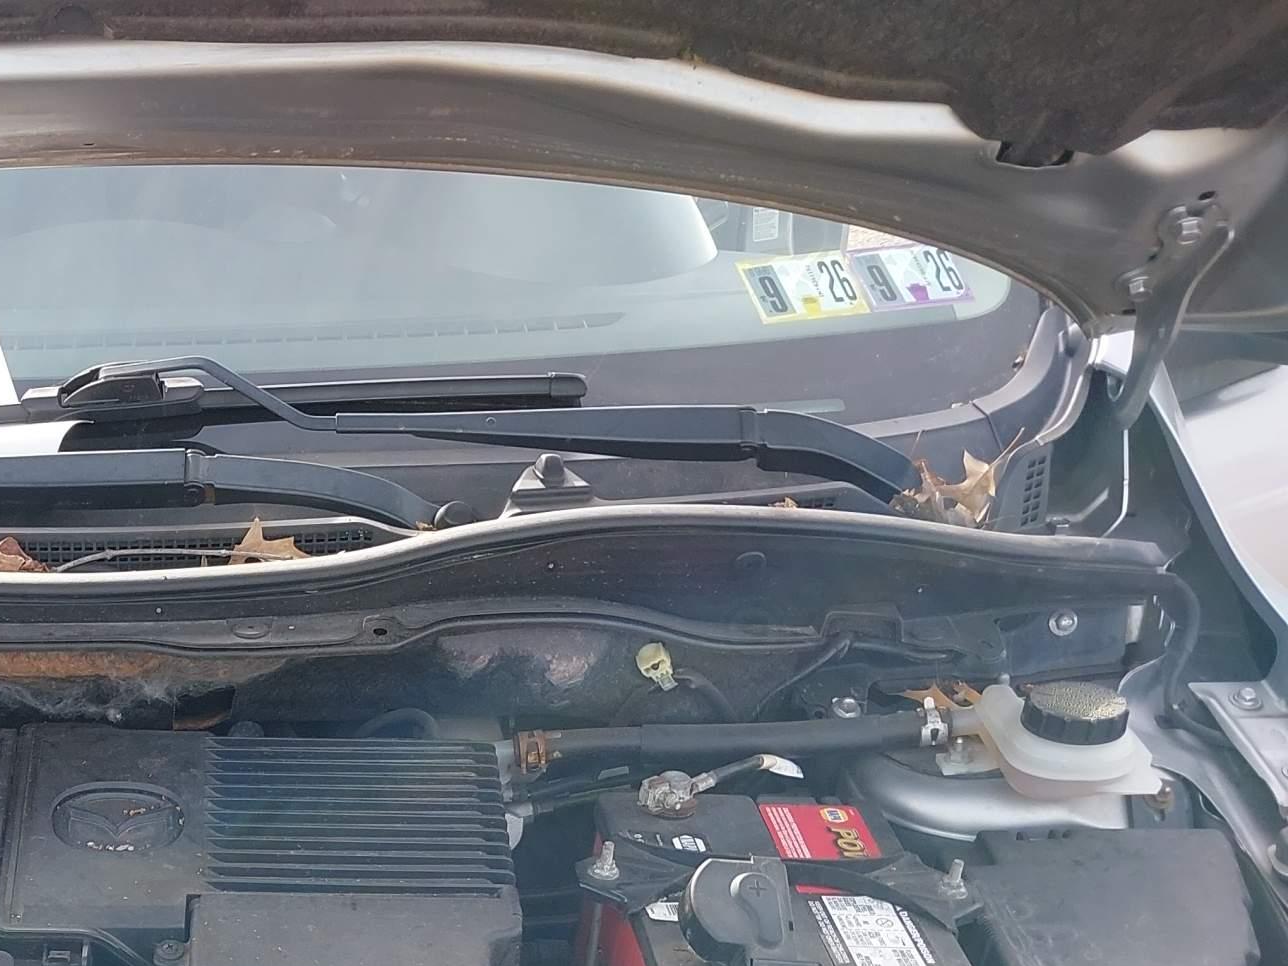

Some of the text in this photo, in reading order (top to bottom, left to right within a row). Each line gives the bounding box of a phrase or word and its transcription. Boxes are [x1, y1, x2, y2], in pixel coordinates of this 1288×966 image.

[817, 259, 858, 303] 26
[866, 264, 898, 302] 9
[923, 249, 964, 292] 26
[758, 275, 789, 313] 9
